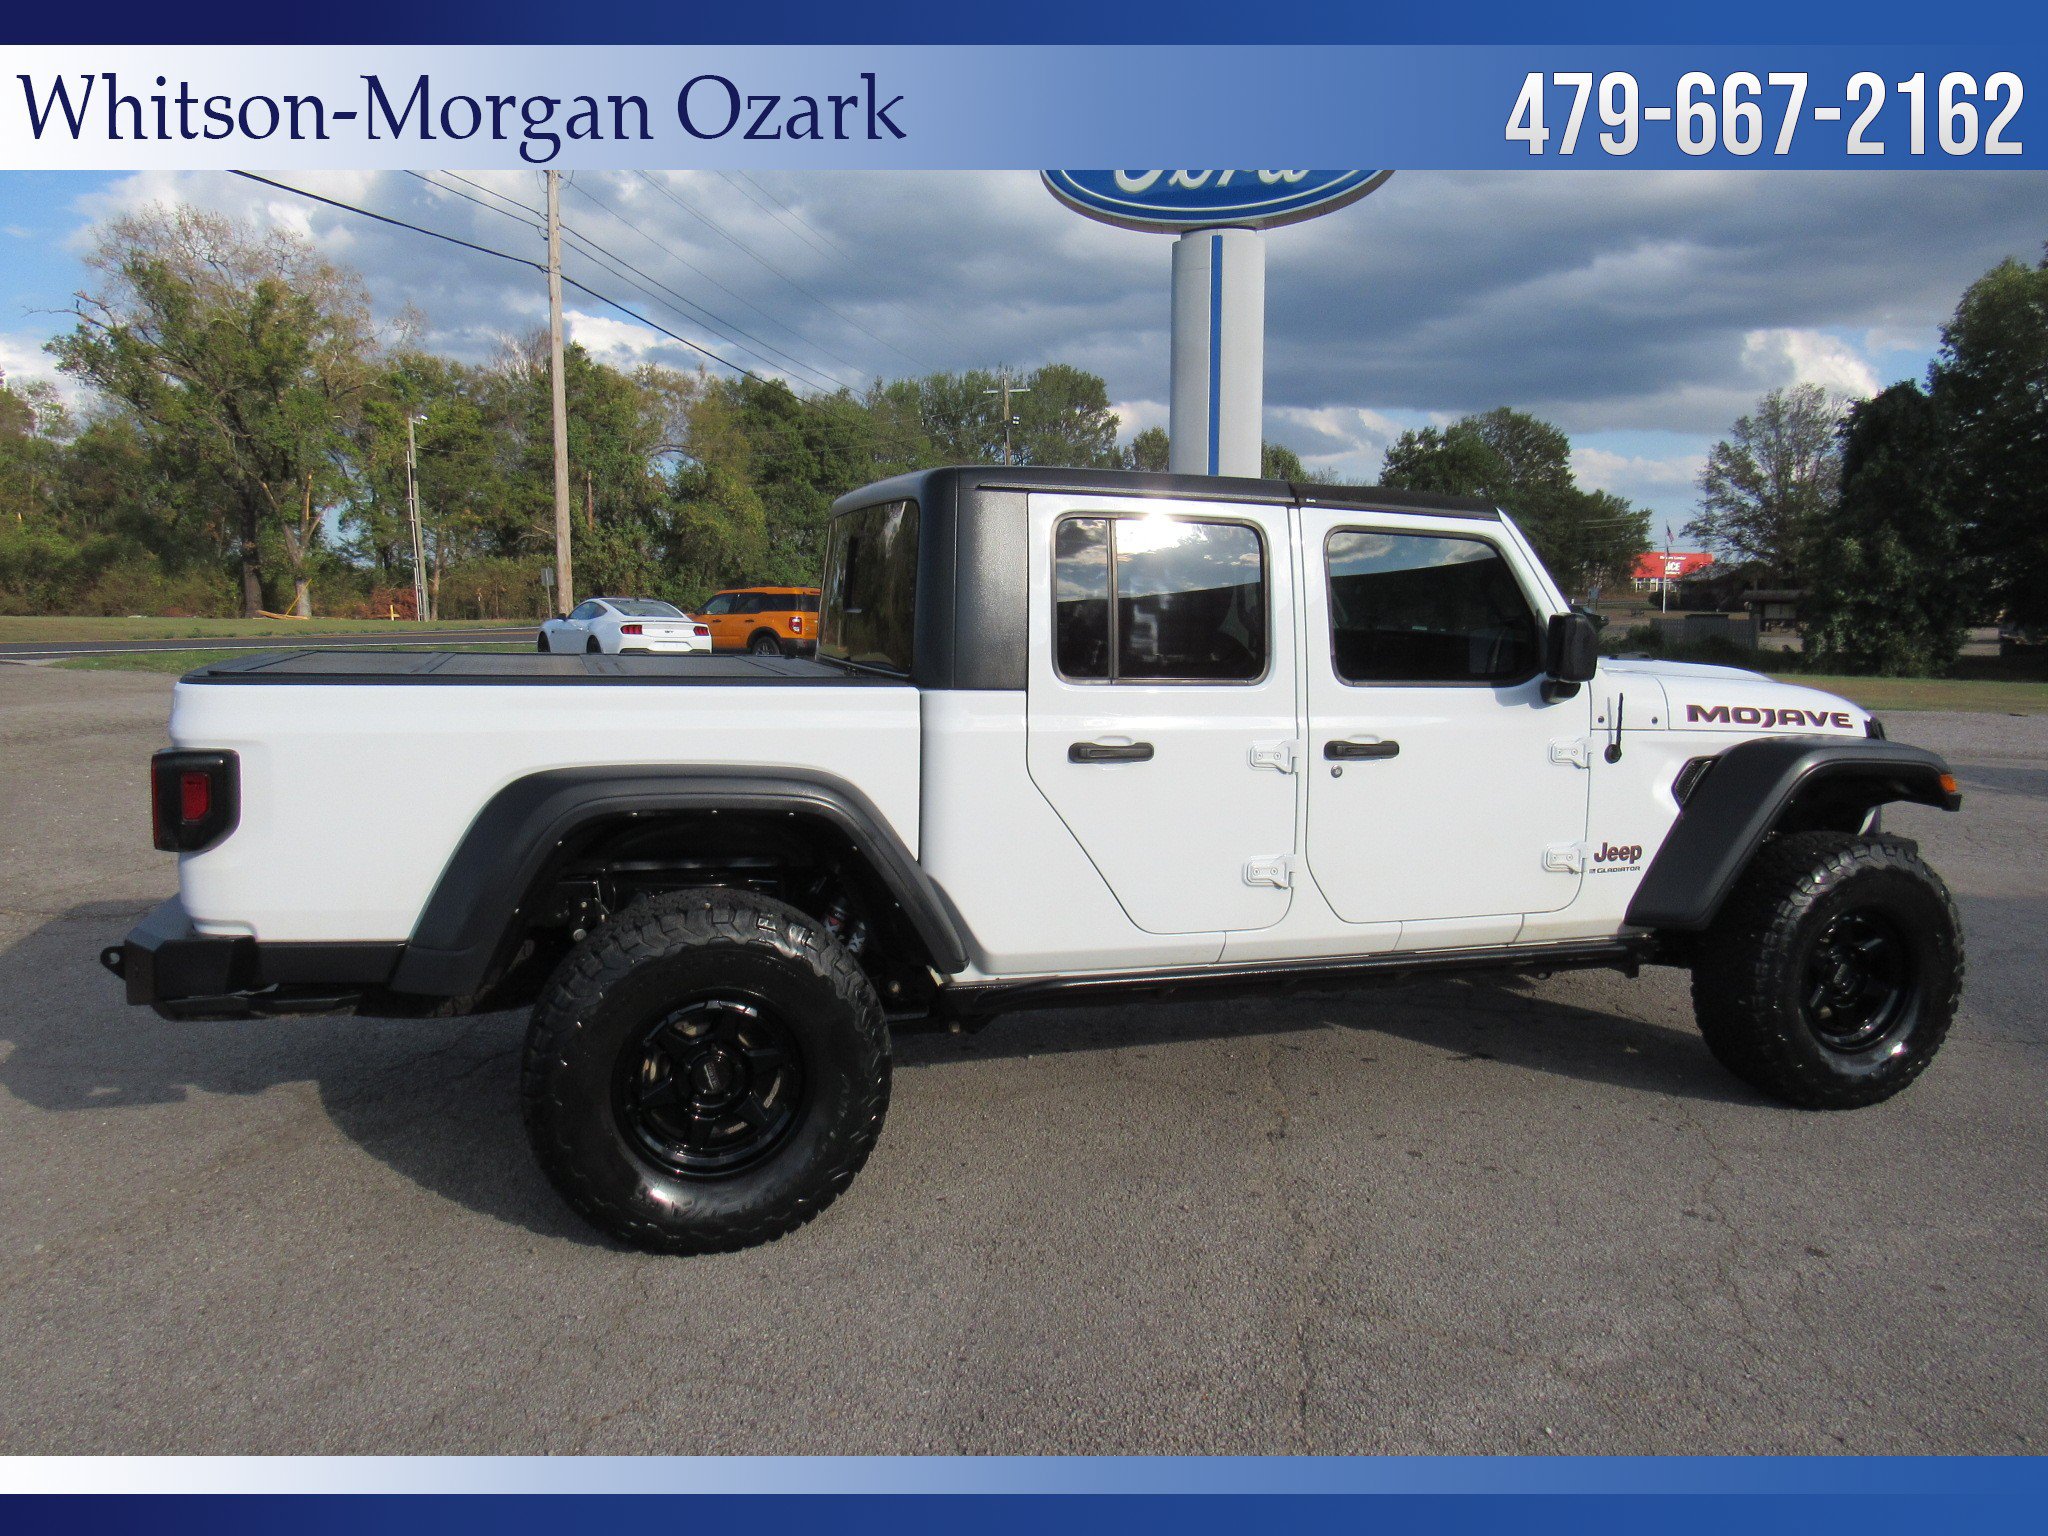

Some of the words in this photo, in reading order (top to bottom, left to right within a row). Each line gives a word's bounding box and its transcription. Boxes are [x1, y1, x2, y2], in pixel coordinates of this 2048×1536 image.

[1686, 704, 1854, 729] MOJAVE
[1593, 841, 1643, 865] Jeep
[1596, 866, 1641, 874] GLADIATOR
